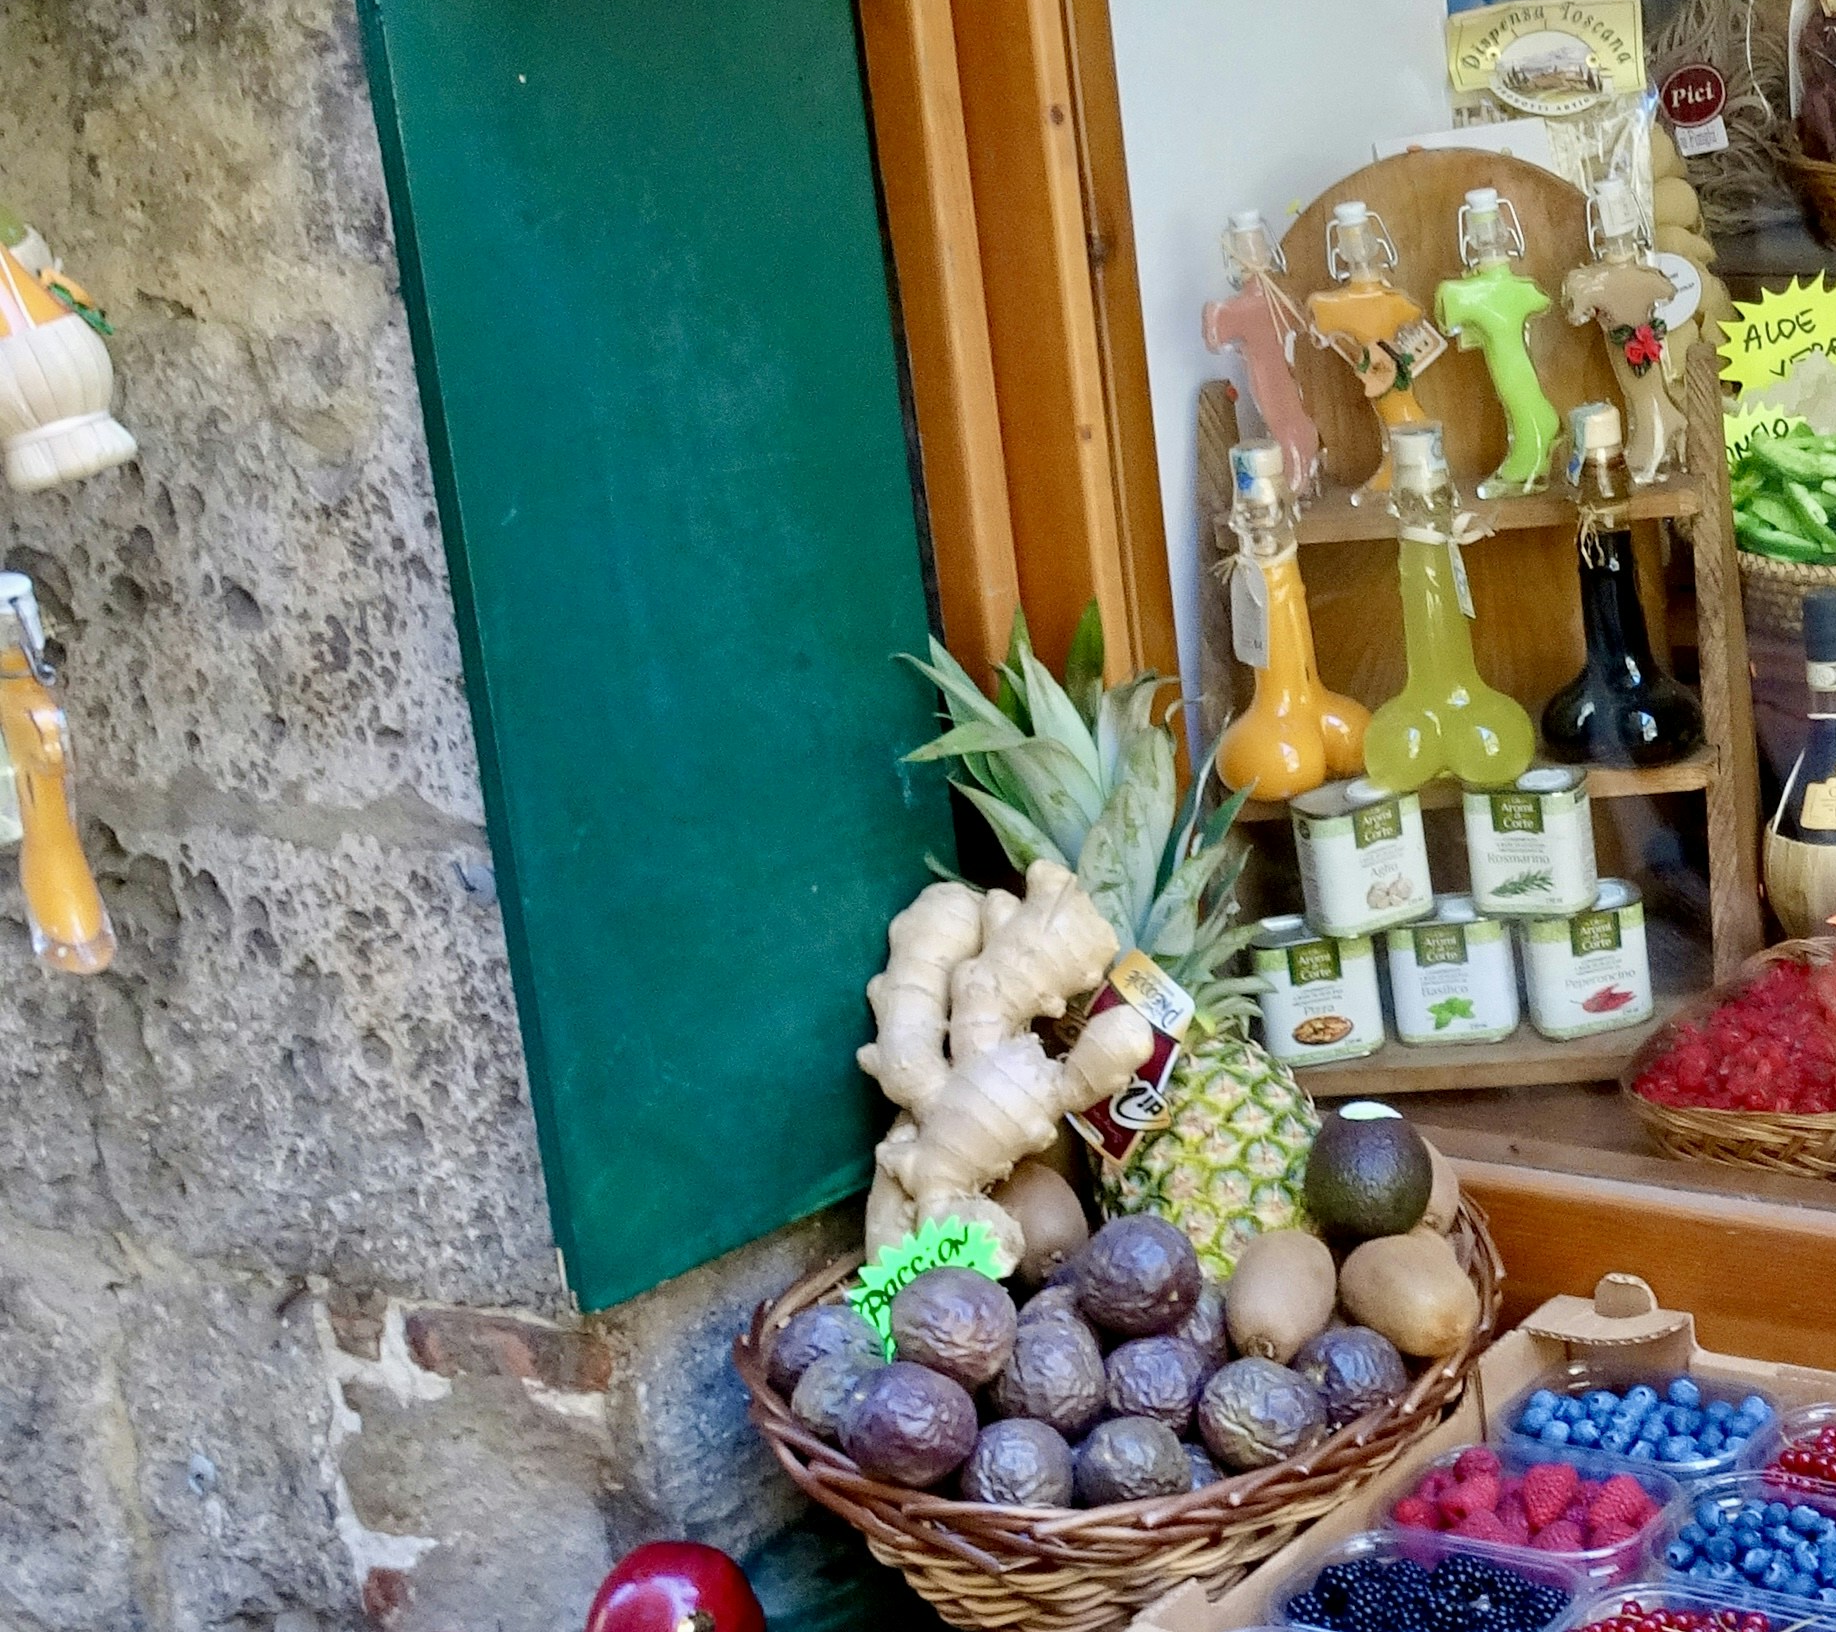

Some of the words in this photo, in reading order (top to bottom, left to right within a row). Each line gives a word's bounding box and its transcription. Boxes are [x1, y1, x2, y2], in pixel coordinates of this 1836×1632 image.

[1461, 4, 1545, 69] Dispensa
[1560, 1, 1632, 65] Toscana
[1671, 80, 1715, 108] Pici
[1743, 308, 1817, 353] ALOE
